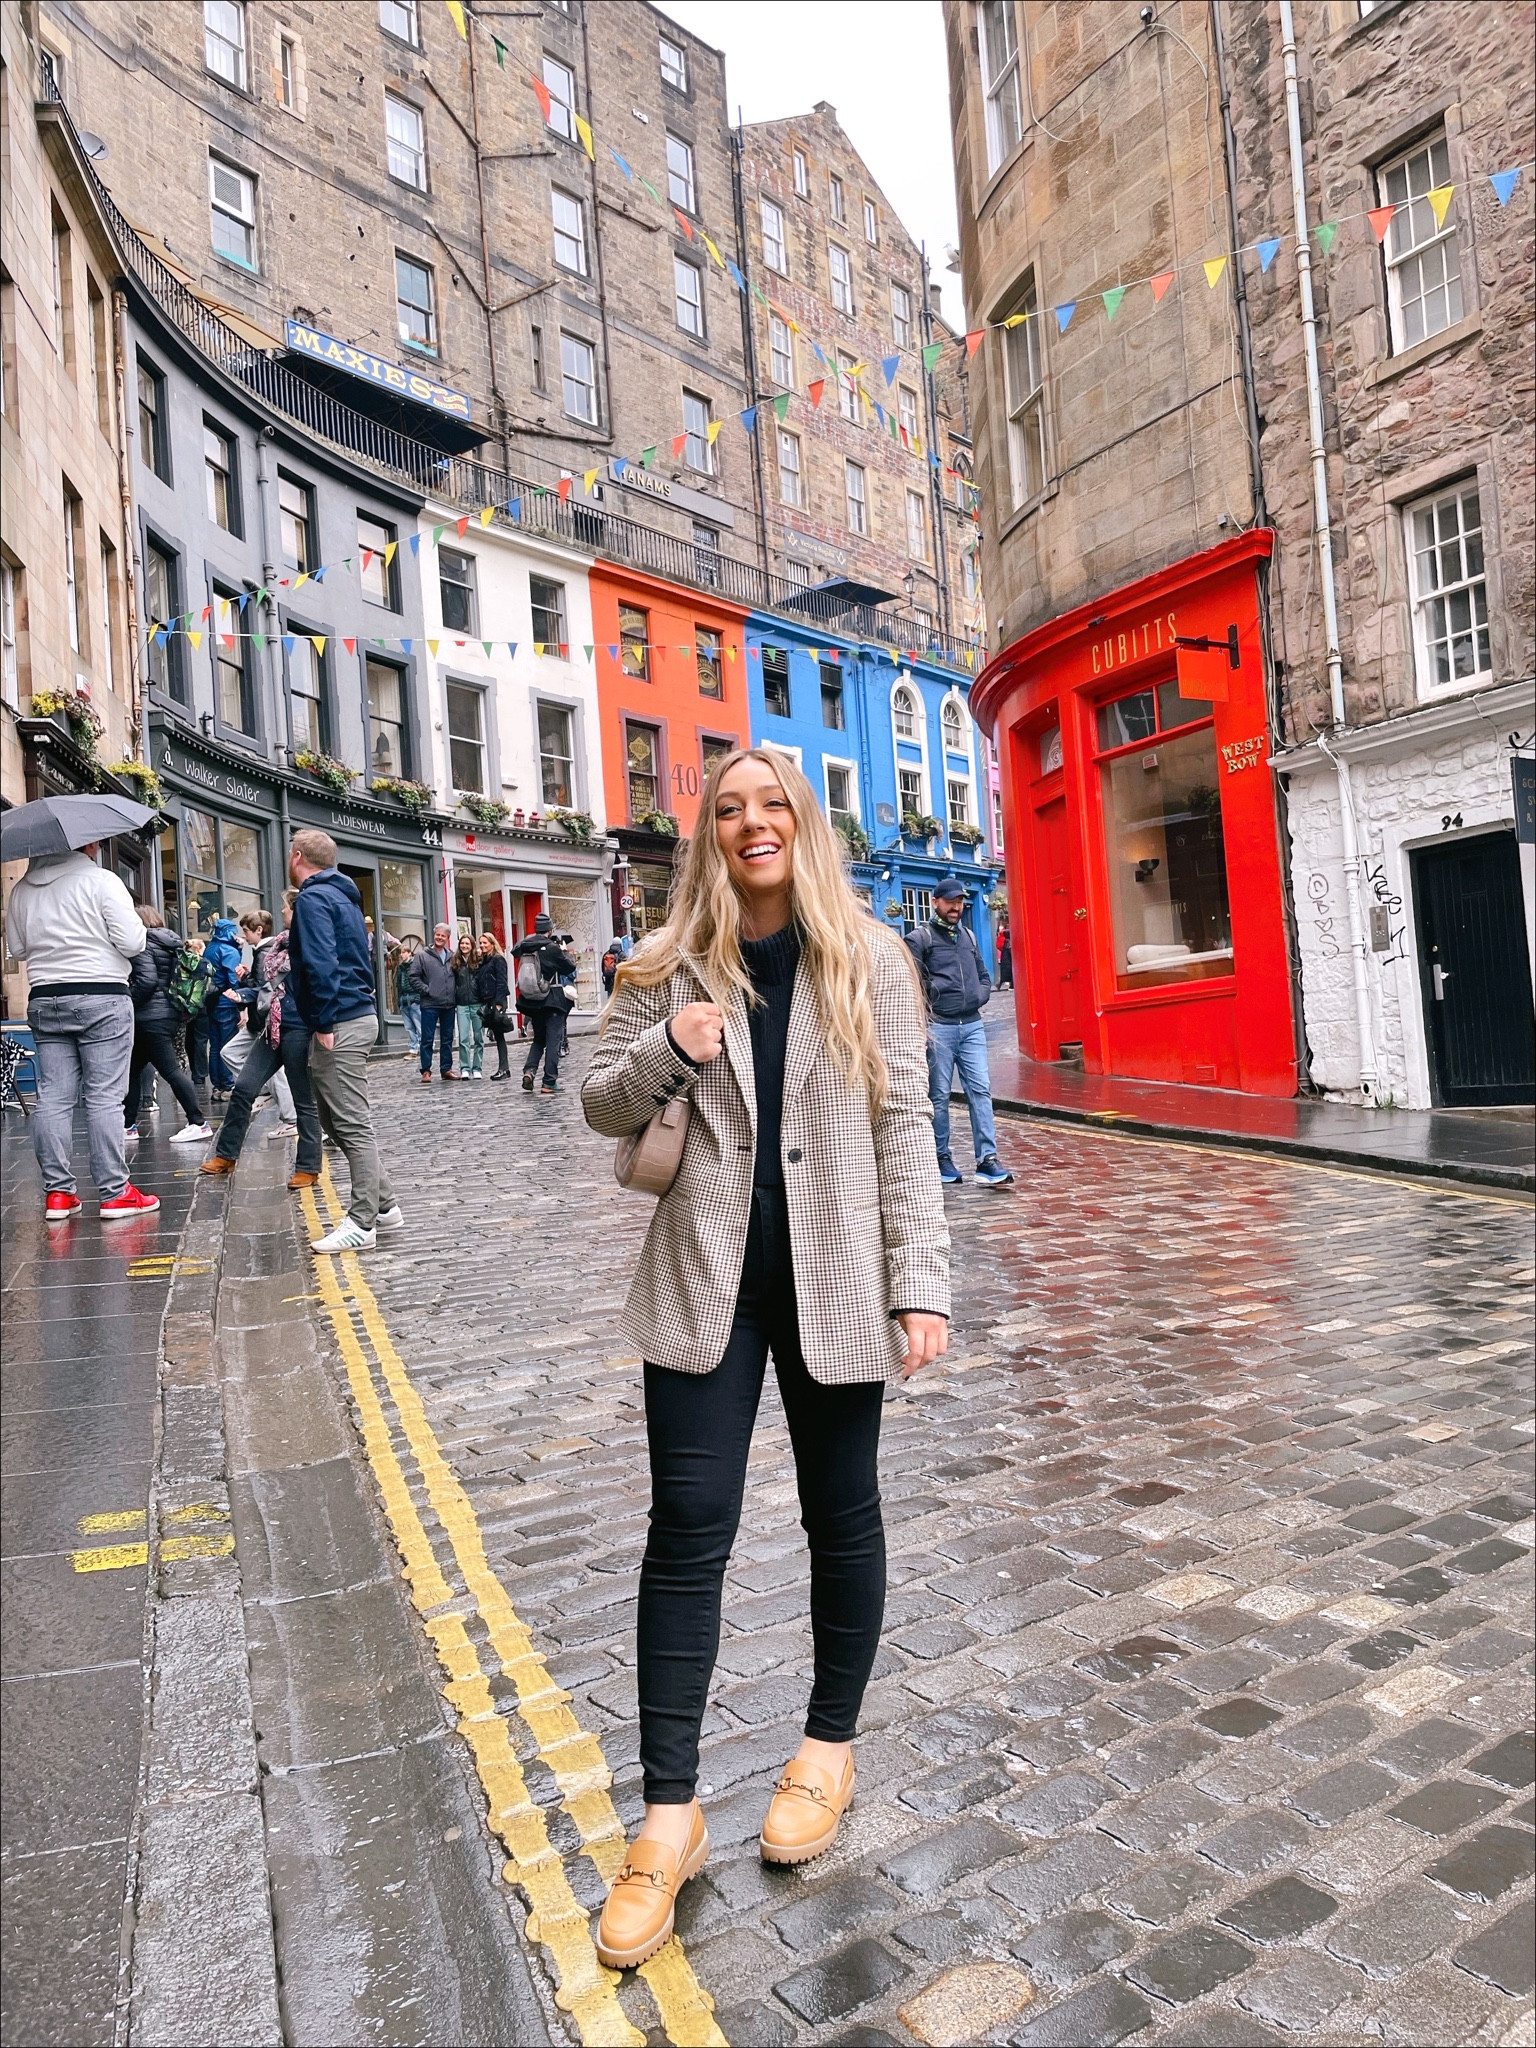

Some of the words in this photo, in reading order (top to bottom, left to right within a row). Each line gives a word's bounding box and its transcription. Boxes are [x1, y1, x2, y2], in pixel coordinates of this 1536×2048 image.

[294, 326, 432, 399] MAXIES
[1092, 612, 1177, 674] CUBITTS
[1221, 735, 1264, 760] WEST
[1227, 751, 1260, 774] BOW
[184, 758, 219, 788] Walker
[226, 776, 260, 803] Slater
[671, 763, 698, 796] 40
[331, 812, 386, 835] LADIESWEAR
[1441, 812, 1464, 831] 94
[466, 841, 476, 850] red
[493, 845, 516, 856] gallery
[621, 898, 633, 906] 20
